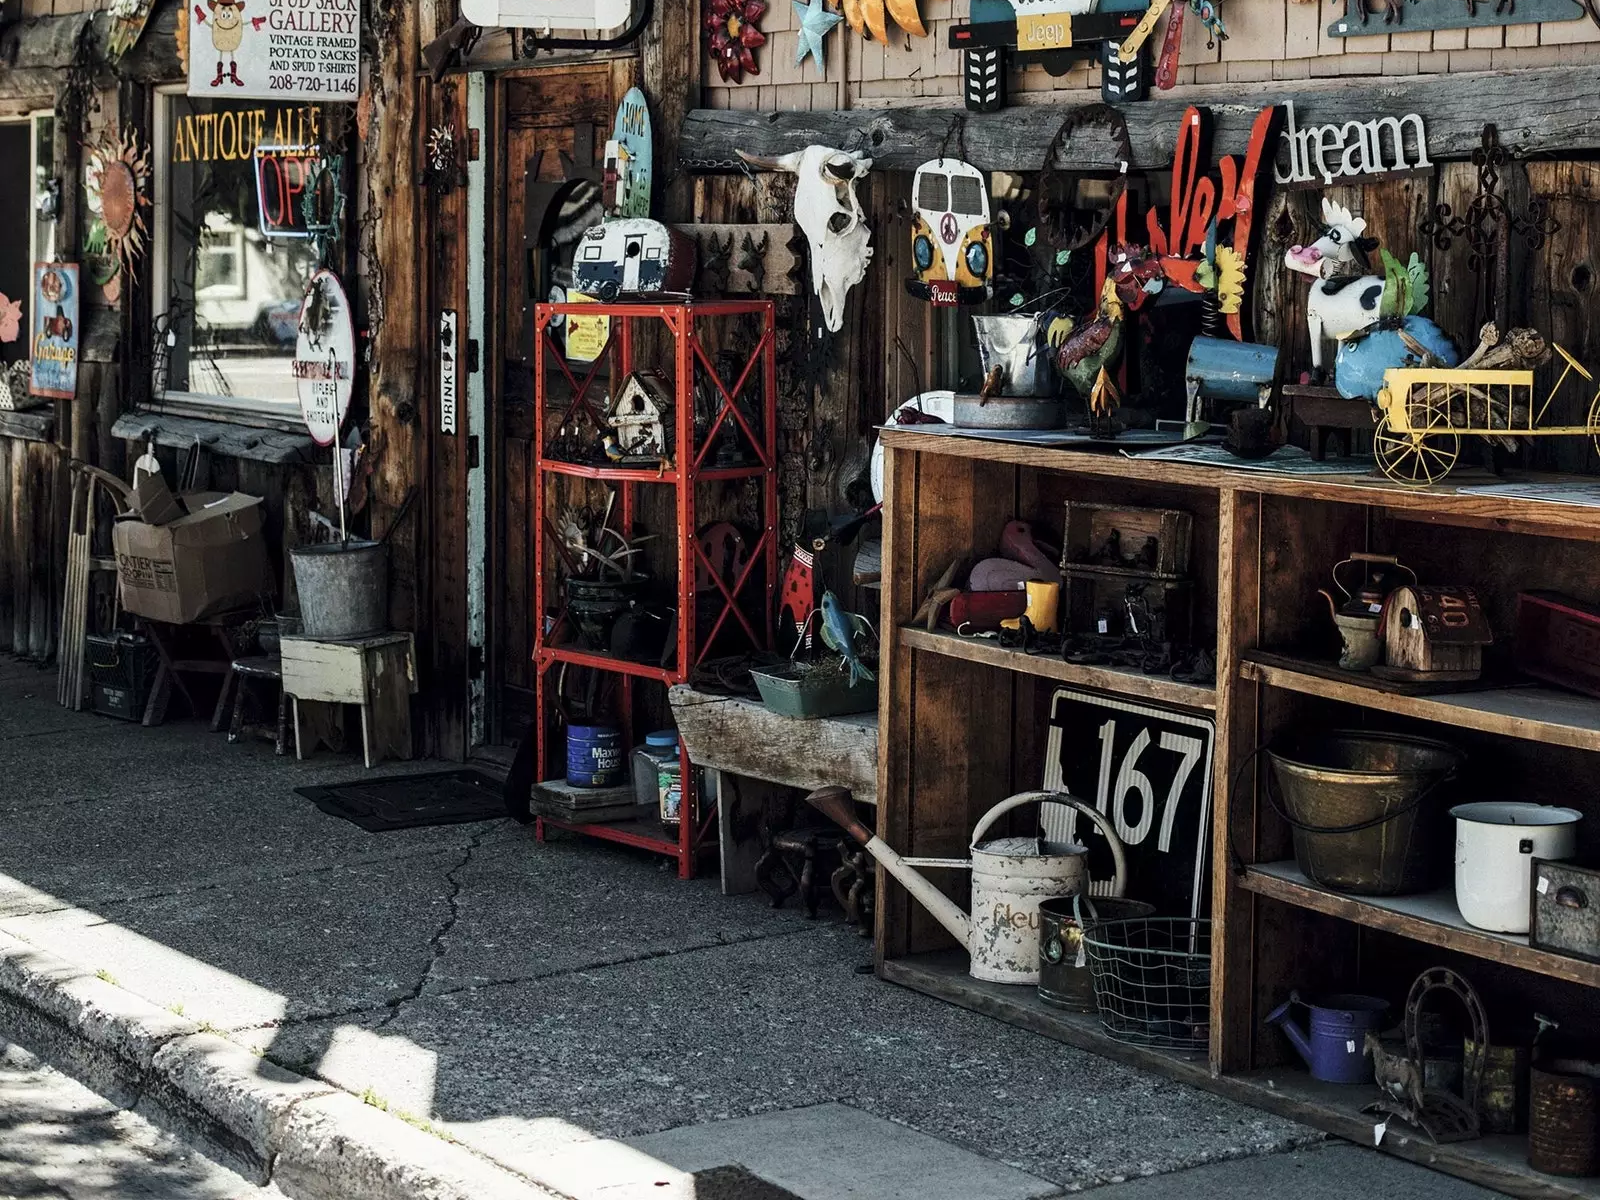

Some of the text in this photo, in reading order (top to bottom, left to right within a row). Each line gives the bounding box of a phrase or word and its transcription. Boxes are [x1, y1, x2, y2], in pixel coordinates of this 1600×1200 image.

[269, 9, 357, 34] GALLERY
[1025, 22, 1064, 45] Jeep
[269, 34, 357, 49] VINTAGE FRAMED
[269, 47, 357, 61] POTATO SACKS
[269, 60, 357, 74] AND SPUD T-SHIRTS
[269, 74, 357, 93] 208-720-1146
[173, 110, 266, 162] ANTIQUE
[1274, 100, 1434, 185] dream
[930, 284, 957, 306] Peace
[443, 375, 453, 426] DRINK
[1093, 719, 1203, 853] 167
[992, 903, 1040, 930] fleu
